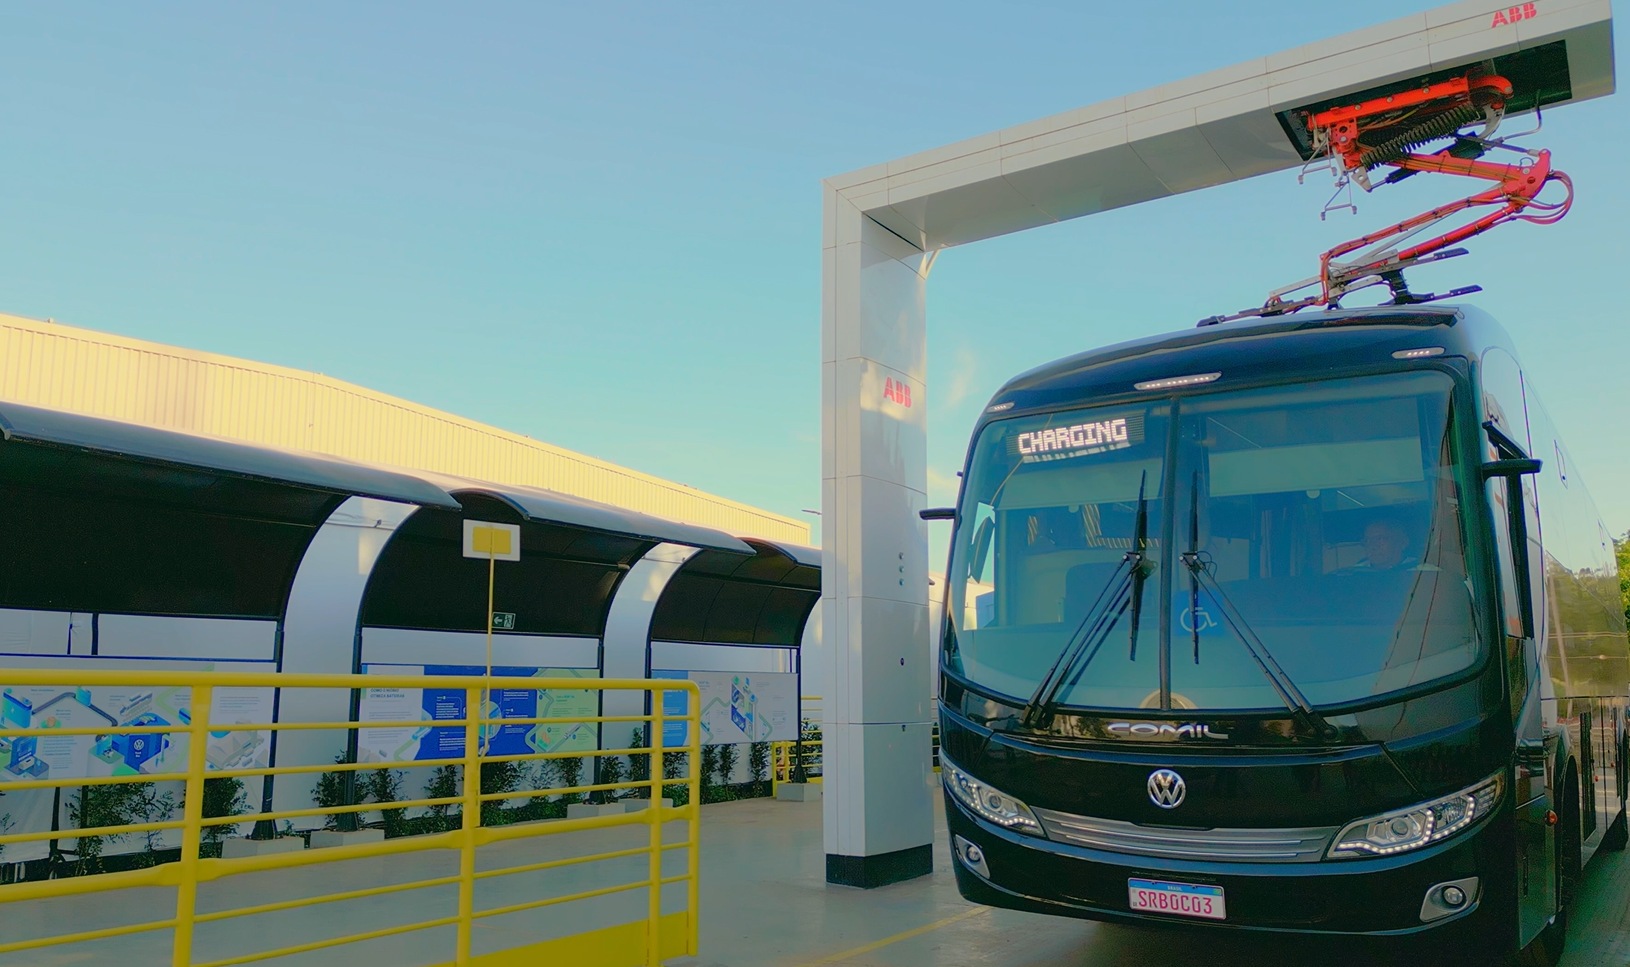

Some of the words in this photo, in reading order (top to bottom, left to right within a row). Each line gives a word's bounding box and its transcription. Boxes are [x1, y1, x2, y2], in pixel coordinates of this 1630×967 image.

[1491, 2, 1537, 28] ABB
[883, 376, 912, 408] ABB
[1018, 418, 1128, 454] CHARGING
[1107, 722, 1229, 739] COMIL
[1147, 768, 1186, 809] VW
[1138, 890, 1212, 914] SRB0C03
